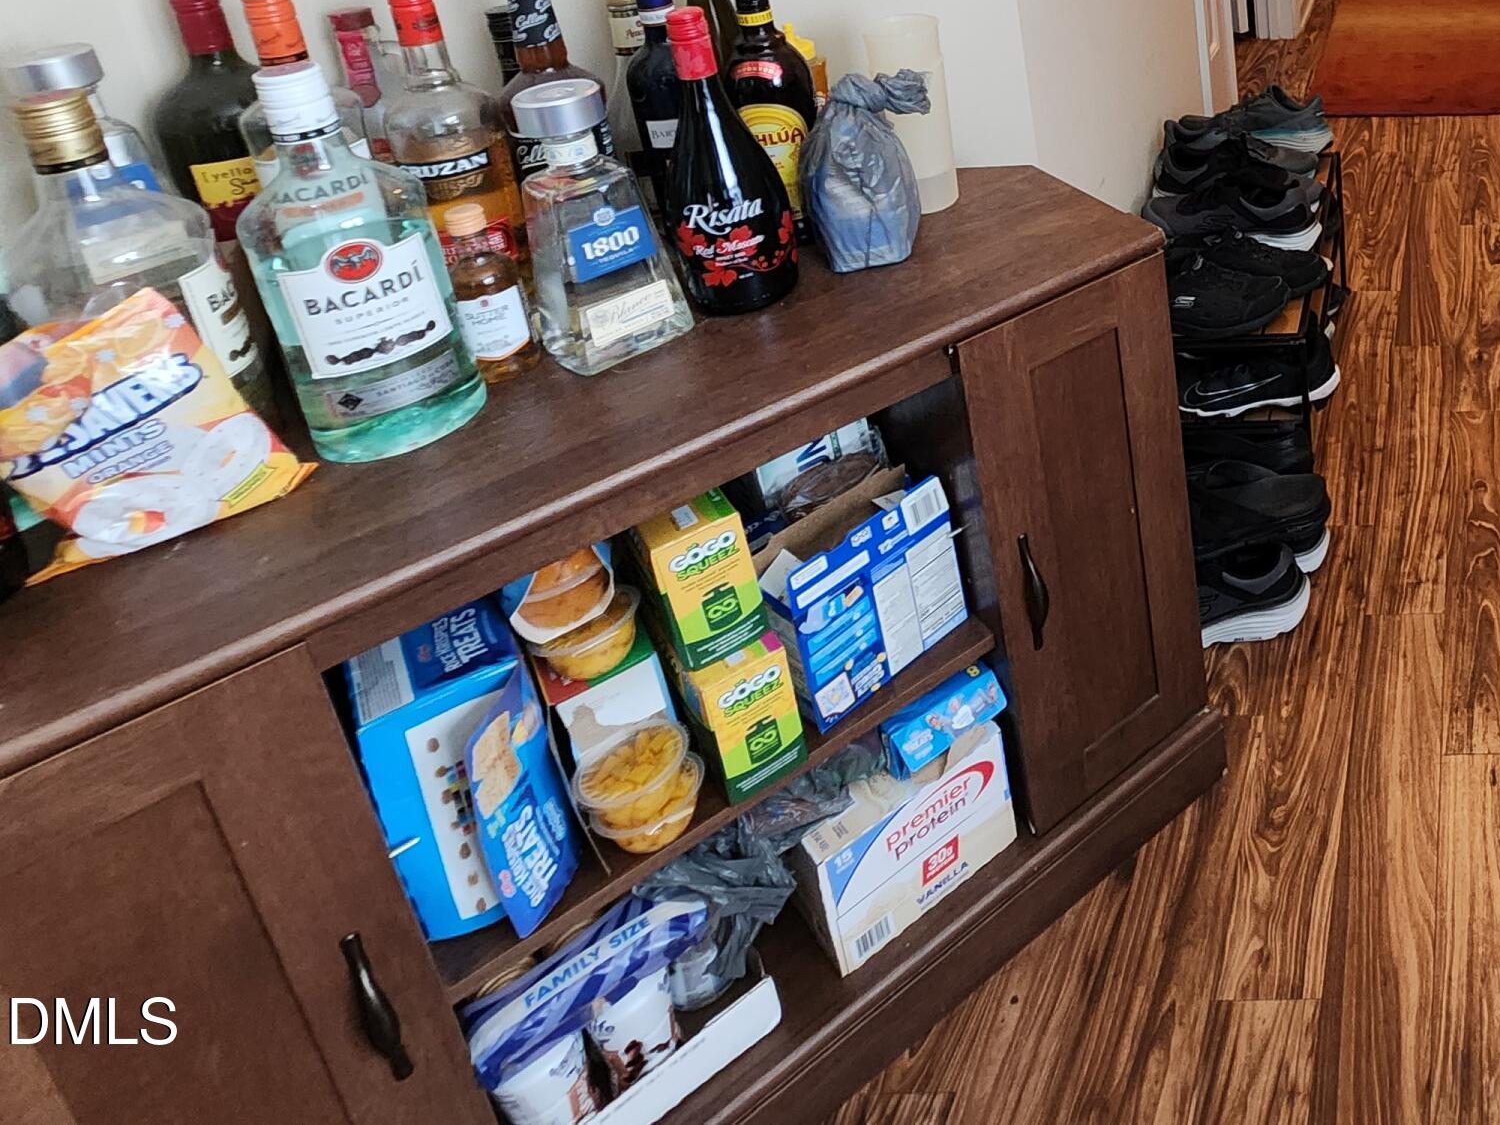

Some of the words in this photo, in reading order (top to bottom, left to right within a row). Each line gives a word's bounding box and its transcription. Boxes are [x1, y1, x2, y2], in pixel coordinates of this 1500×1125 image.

[516, 144, 550, 168] Coll
[683, 196, 765, 236] Risata
[581, 225, 641, 261] 1800
[303, 259, 425, 318] BACARDÍ
[333, 295, 411, 327] SUPERIOR
[60, 418, 168, 480] MINTS
[87, 440, 175, 486] ORANGE
[676, 545, 742, 582] SQUEEZ
[450, 607, 489, 664] TREATS
[724, 677, 784, 718] SQUEEZ
[886, 776, 972, 853] premier
[895, 797, 967, 861] protein
[916, 860, 970, 905] VANILLA
[523, 945, 602, 1010] FAMILY
[608, 915, 652, 949] SIZE
